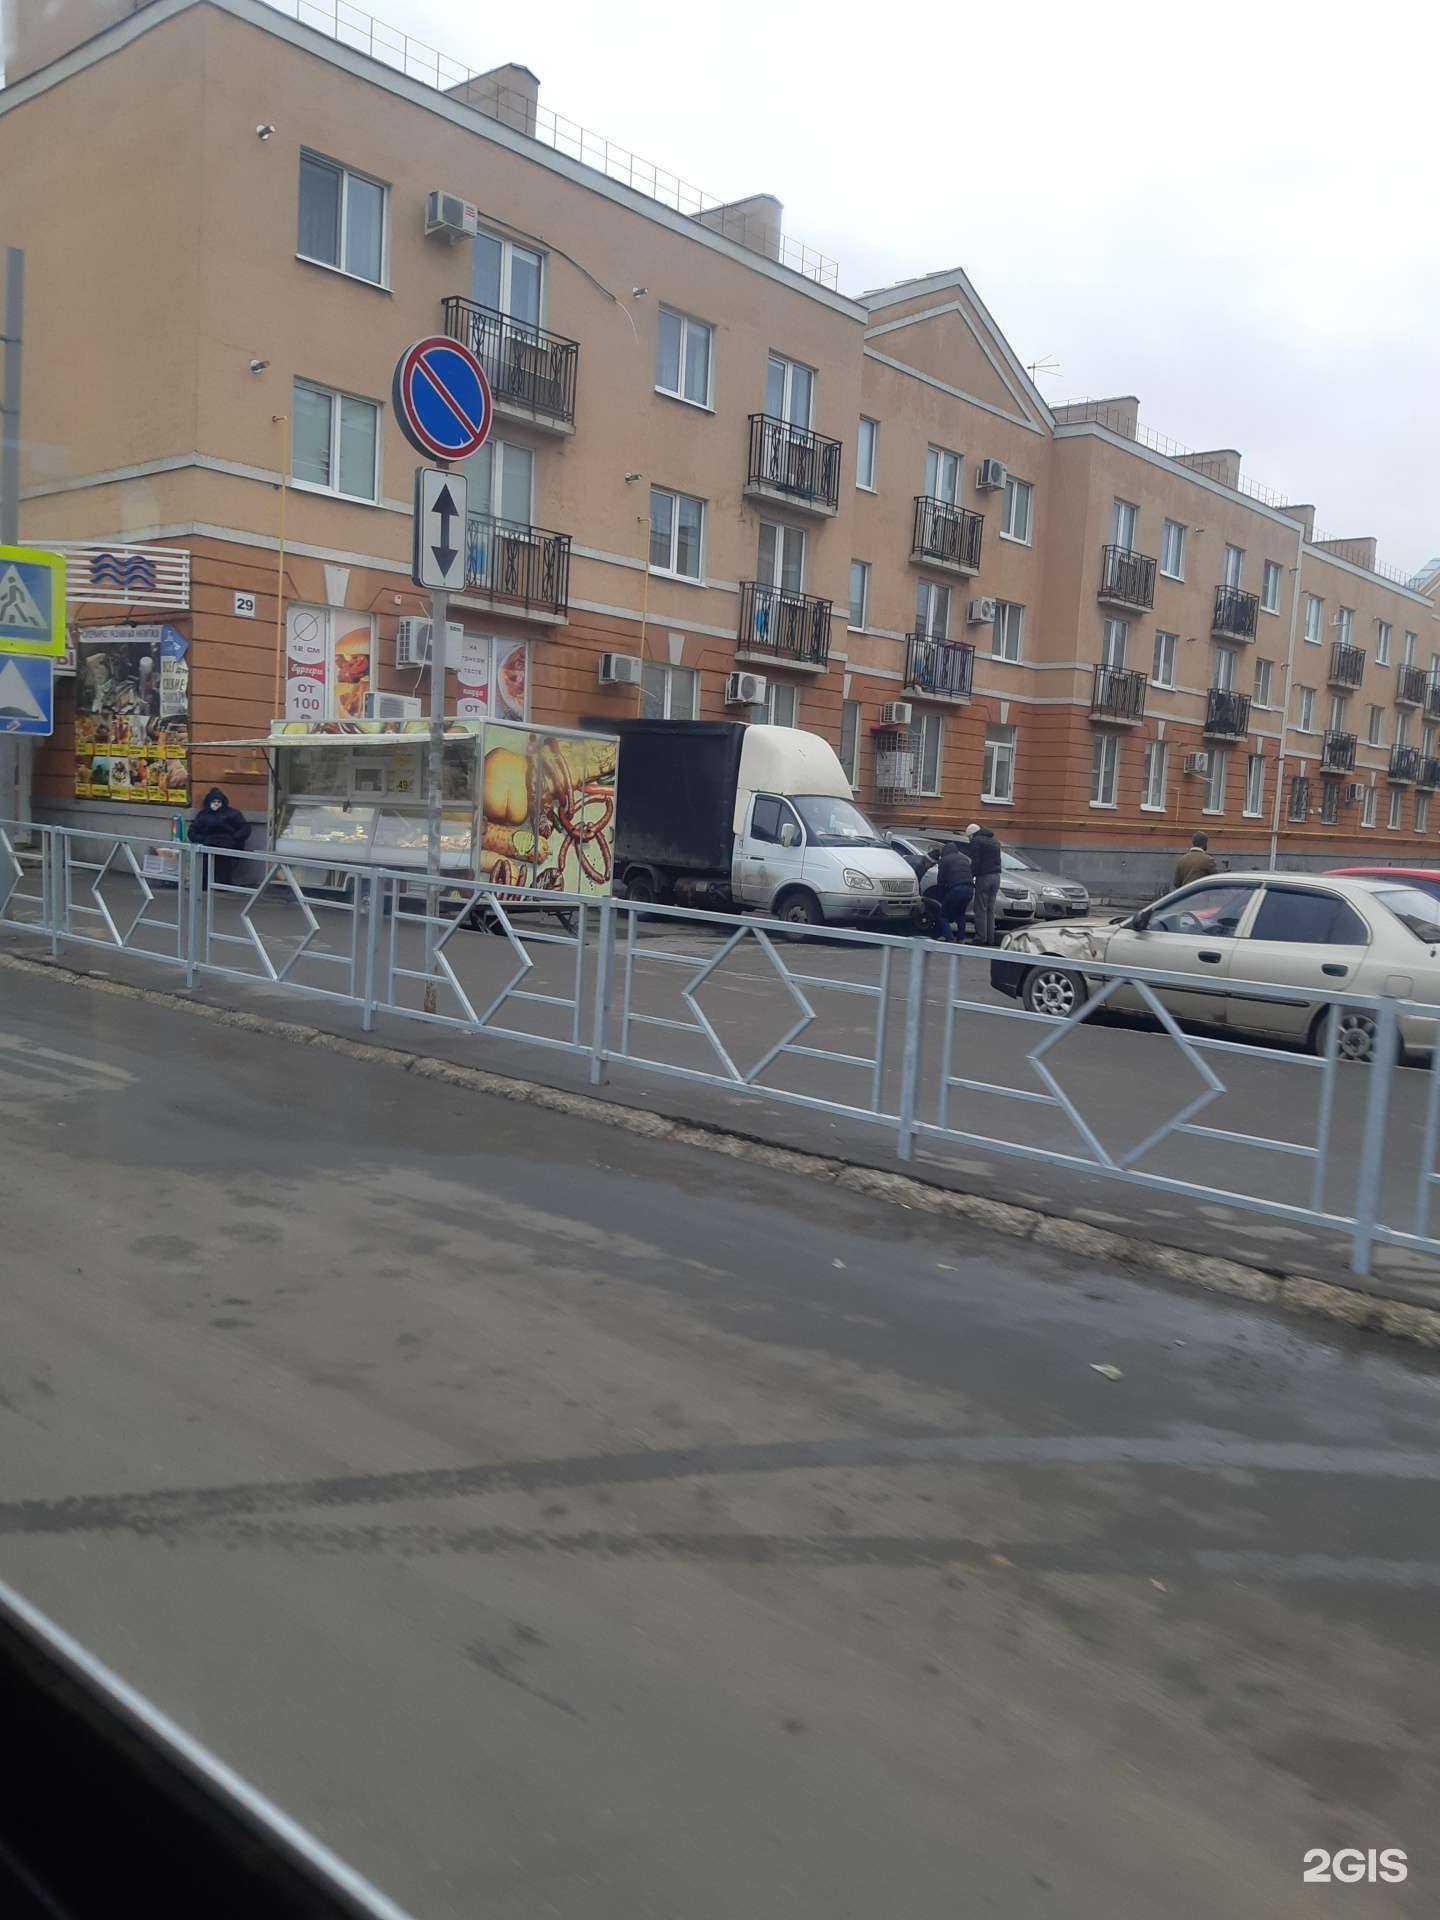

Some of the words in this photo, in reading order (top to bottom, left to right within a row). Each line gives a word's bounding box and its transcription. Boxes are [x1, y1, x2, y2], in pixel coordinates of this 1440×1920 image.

[236, 598, 254, 611] 29
[297, 683, 315, 693] ОТ
[293, 697, 320, 710] 100
[464, 704, 480, 713] ОТ
